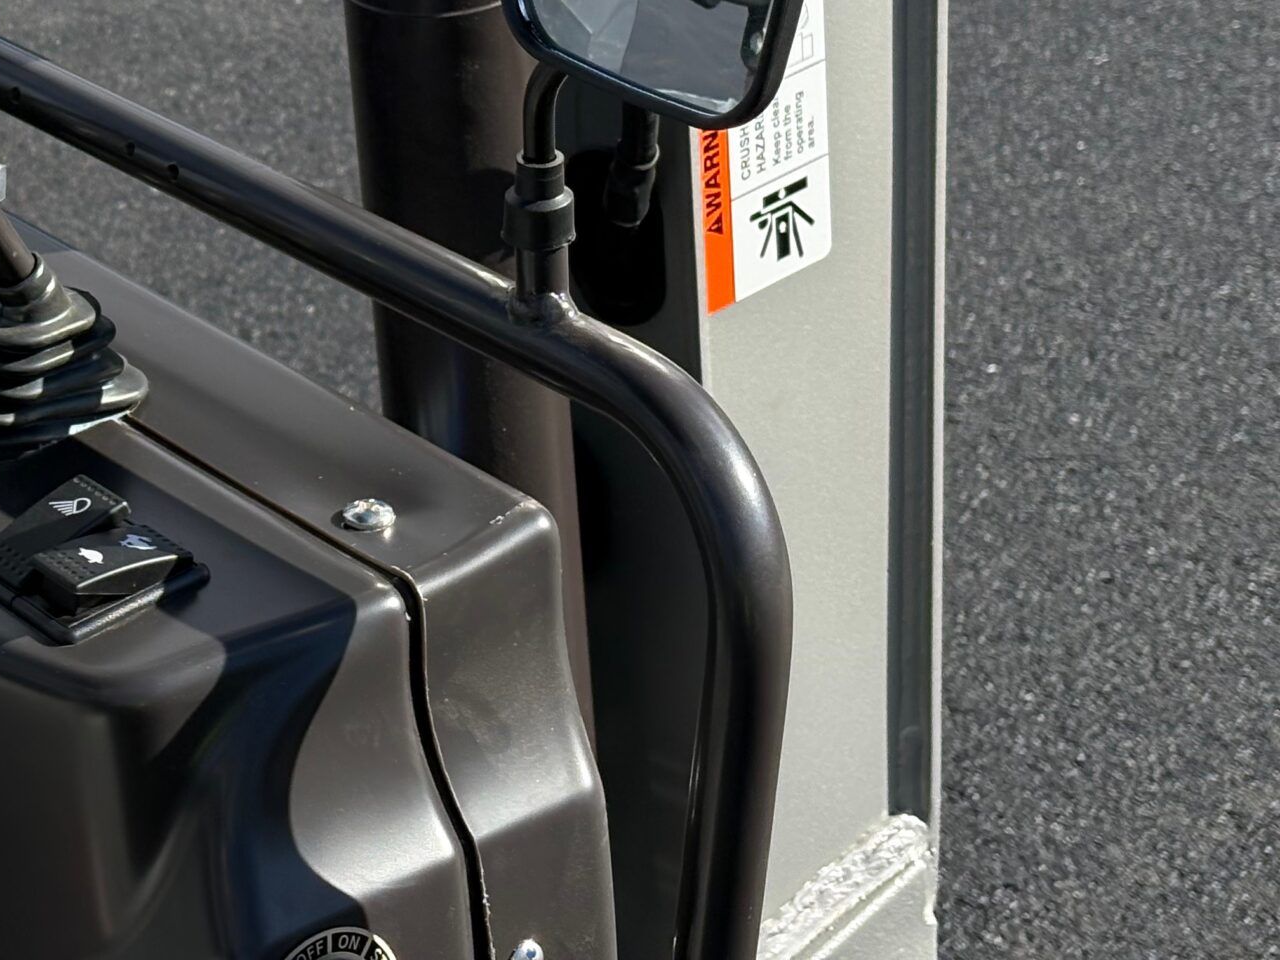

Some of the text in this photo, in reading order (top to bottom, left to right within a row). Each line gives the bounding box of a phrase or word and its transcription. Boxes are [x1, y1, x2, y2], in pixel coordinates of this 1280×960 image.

[755, 114, 766, 174] HAZAR
[772, 131, 782, 166] Keep
[783, 104, 792, 161] from the
[795, 91, 805, 154] operating
[807, 115, 815, 149] area.
[703, 128, 722, 218] WARN
[740, 126, 751, 181] CRUSH
[338, 934, 360, 951] ON
